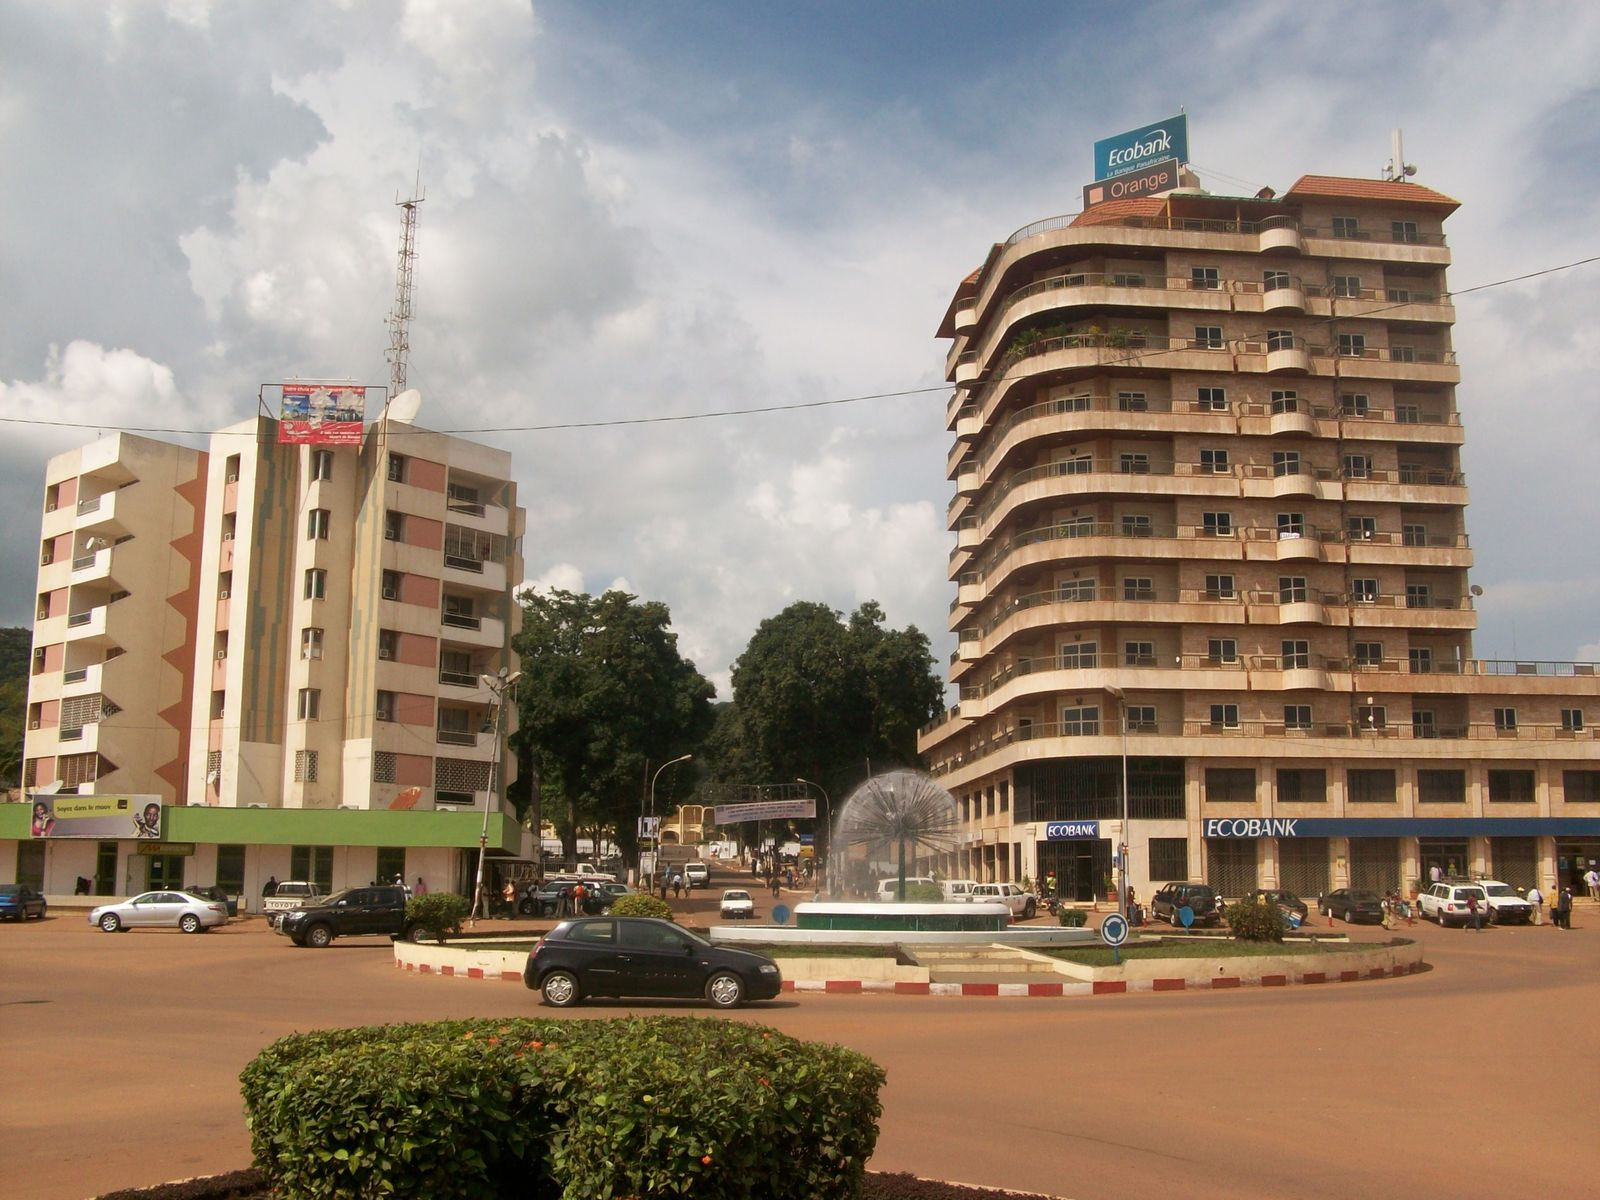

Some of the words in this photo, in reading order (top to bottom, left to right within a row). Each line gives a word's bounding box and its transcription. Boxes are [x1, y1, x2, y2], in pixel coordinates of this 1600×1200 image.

[1108, 129, 1172, 167] Ecobank
[1110, 172, 1169, 198] Orange
[1048, 824, 1096, 837] ECOBANK
[1207, 819, 1299, 837] ECOBANK
